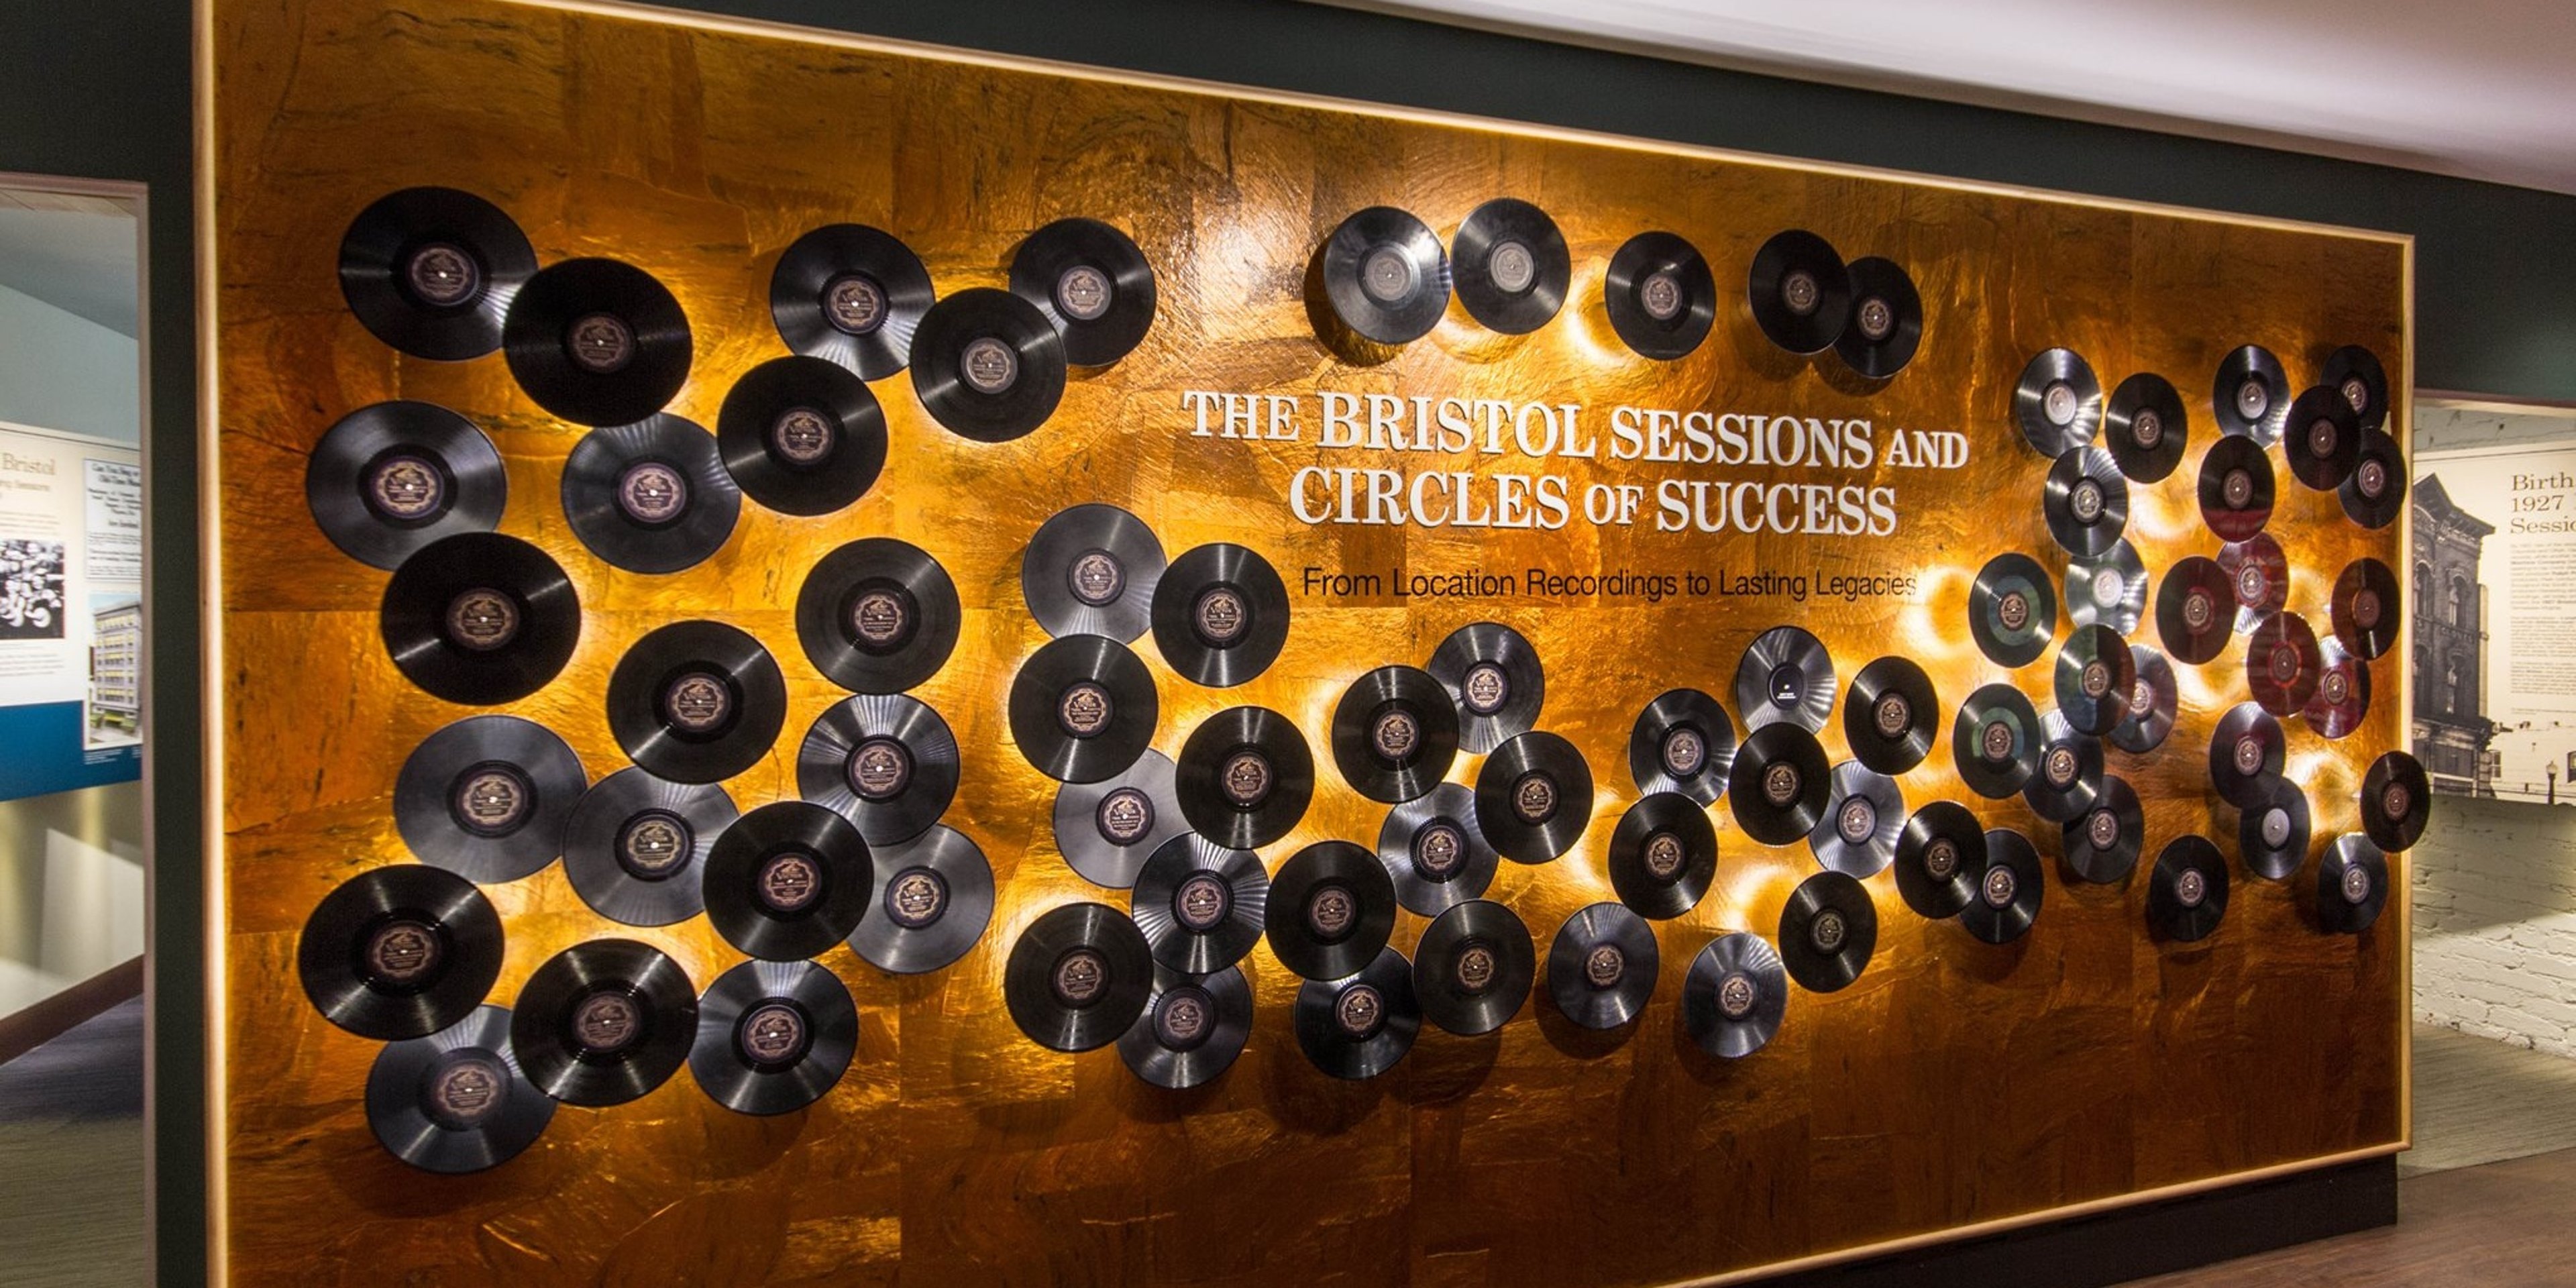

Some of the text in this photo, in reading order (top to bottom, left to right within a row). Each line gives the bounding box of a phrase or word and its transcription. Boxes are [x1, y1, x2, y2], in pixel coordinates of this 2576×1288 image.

[1183, 390, 1969, 470] THE BRISTOL SESSIONS AND
[3, 452, 56, 476] Bristol
[2512, 472, 2573, 491] Birth
[1289, 466, 1897, 537] CIRCLES OF SUCCESS
[2512, 494, 2565, 513] 1927
[1303, 567, 1917, 602] From Location Recordings to Lasting Legacies
